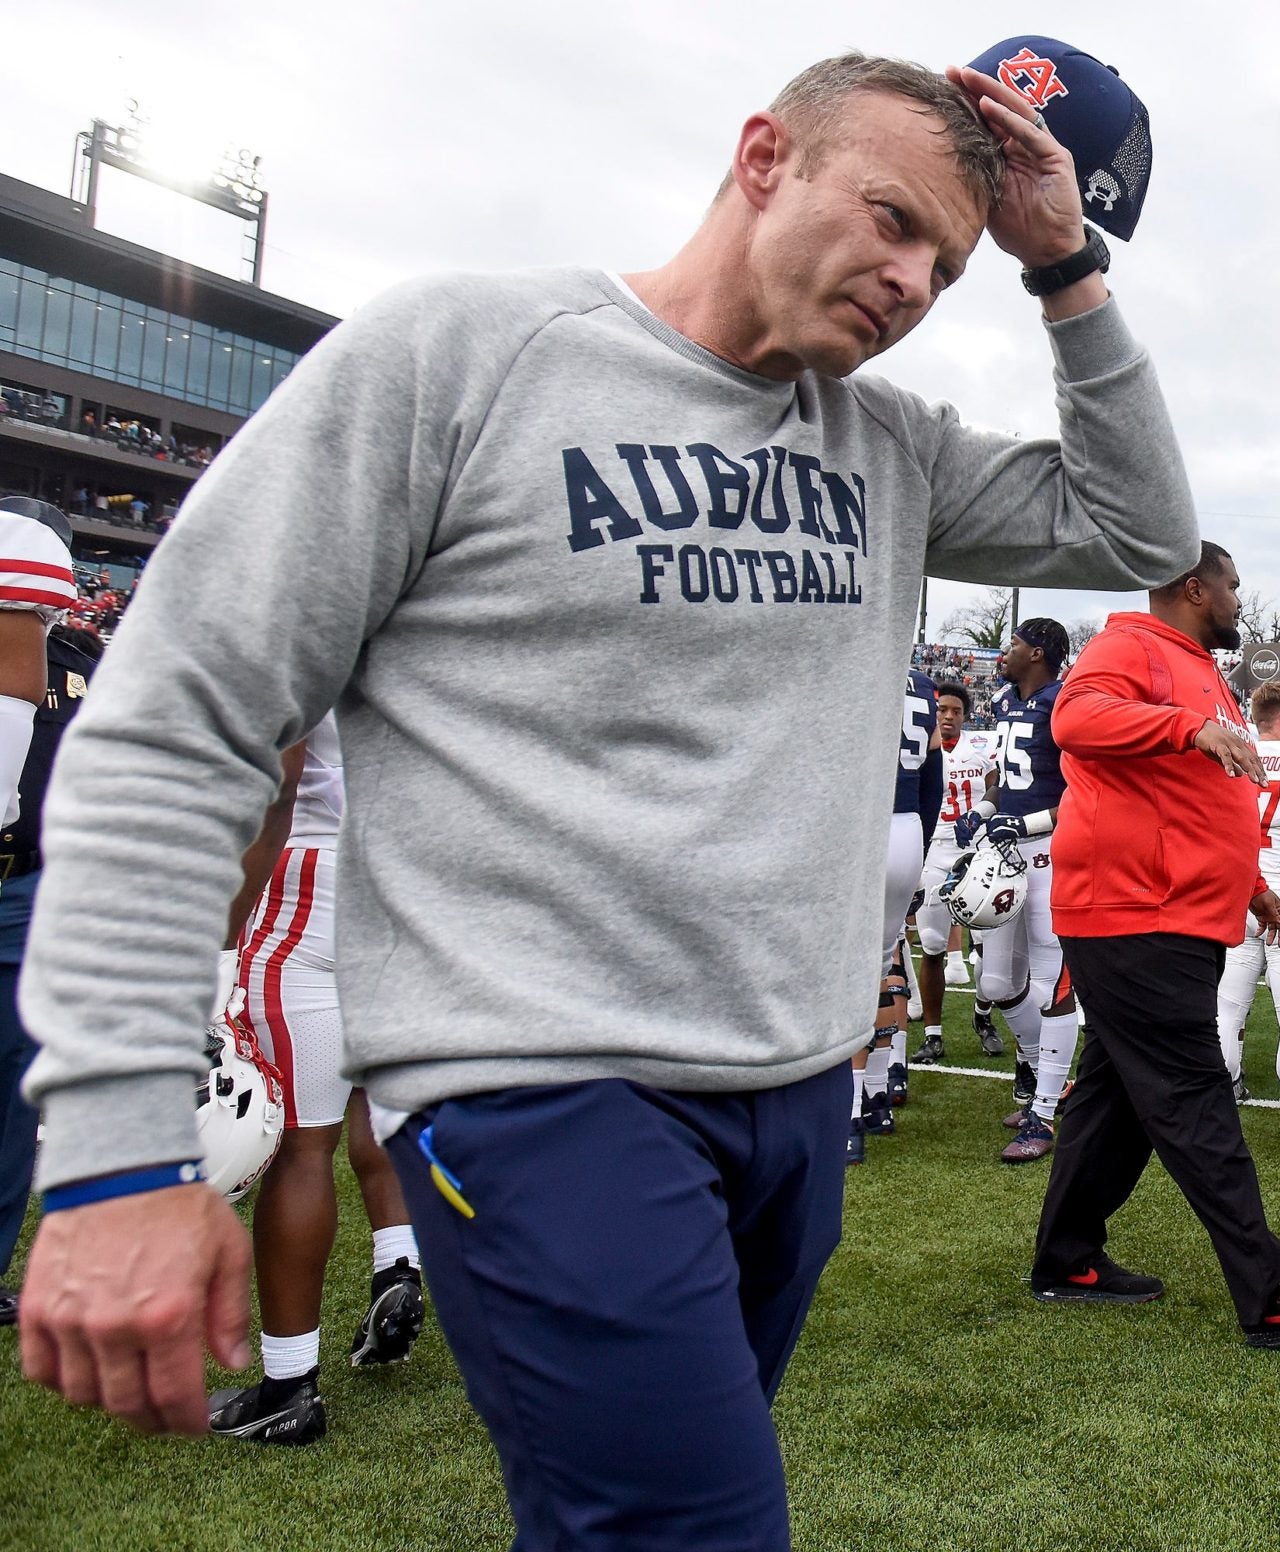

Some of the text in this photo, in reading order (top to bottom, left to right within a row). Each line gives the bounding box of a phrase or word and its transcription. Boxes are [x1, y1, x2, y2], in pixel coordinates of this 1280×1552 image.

[562, 443, 867, 557] AUBURN
[636, 544, 862, 604] FOOTBALL
[900, 695, 929, 770] 5
[941, 780, 972, 822] 31
[948, 768, 983, 780] STON
